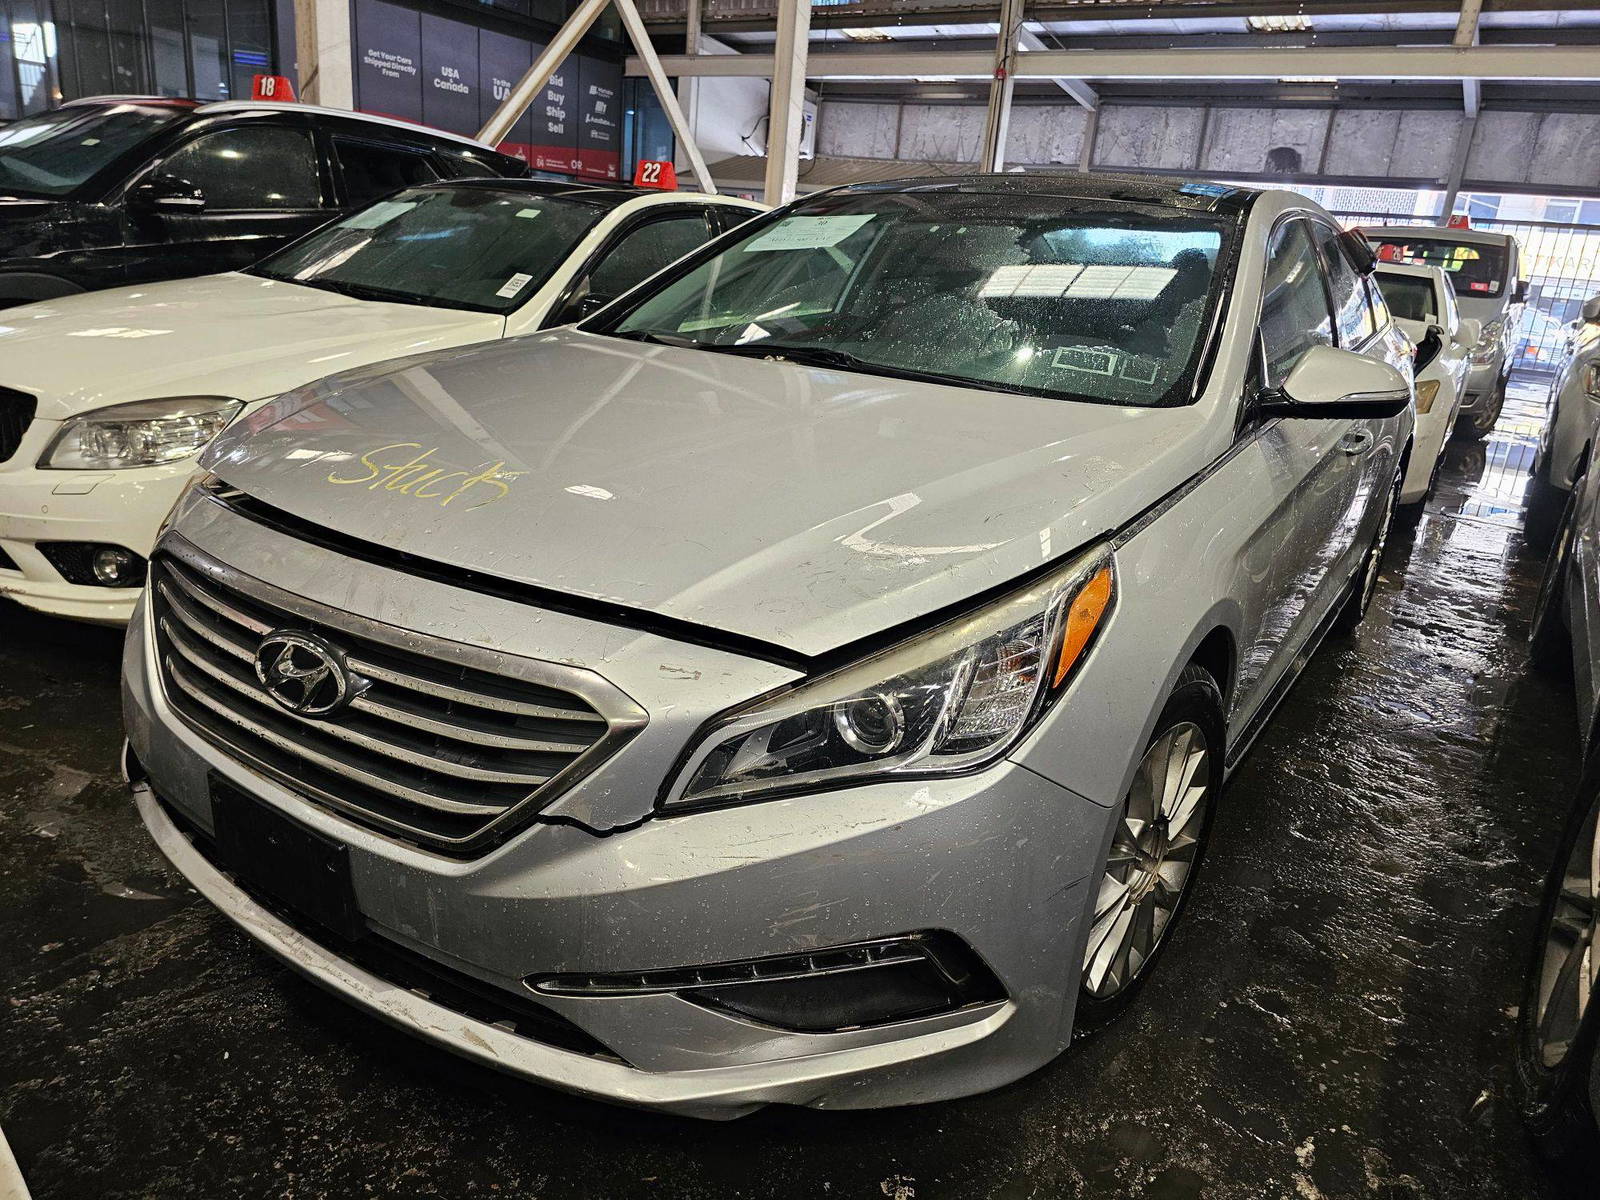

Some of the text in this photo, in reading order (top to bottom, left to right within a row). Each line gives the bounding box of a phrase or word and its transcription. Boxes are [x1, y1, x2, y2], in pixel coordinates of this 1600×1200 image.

[381, 52, 397, 61] Your
[364, 56, 417, 76] Shipped Directly
[382, 68, 400, 78] From
[441, 66, 460, 79] USA
[261, 76, 275, 96] 18
[433, 78, 469, 94] Canada
[549, 74, 564, 87] Bid
[547, 90, 565, 106] Buy
[546, 106, 566, 121] Ship
[548, 122, 564, 134] Sell
[642, 162, 660, 183] 22
